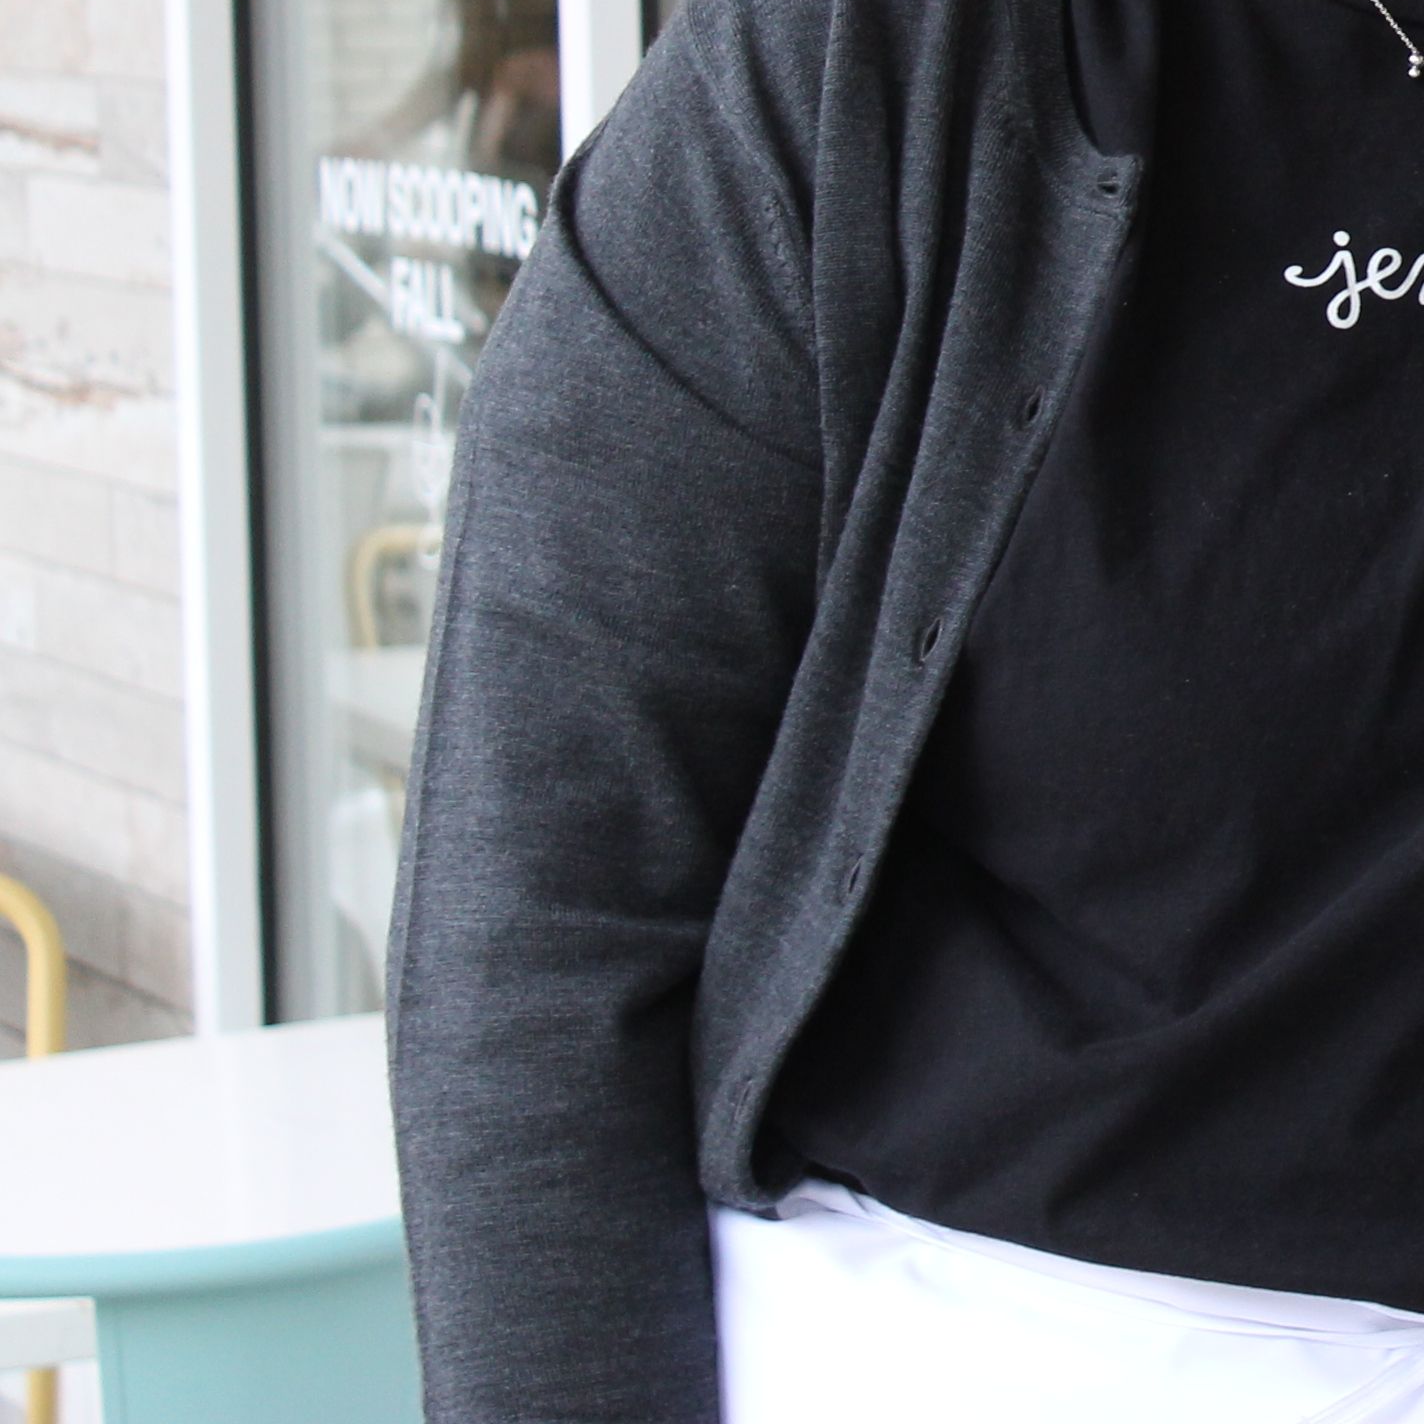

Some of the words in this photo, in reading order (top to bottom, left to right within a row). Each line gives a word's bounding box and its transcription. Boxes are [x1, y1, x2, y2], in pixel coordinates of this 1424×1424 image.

[318, 154, 386, 235] NOW
[387, 161, 539, 261] SCOOPING
[390, 255, 466, 344] FALL
